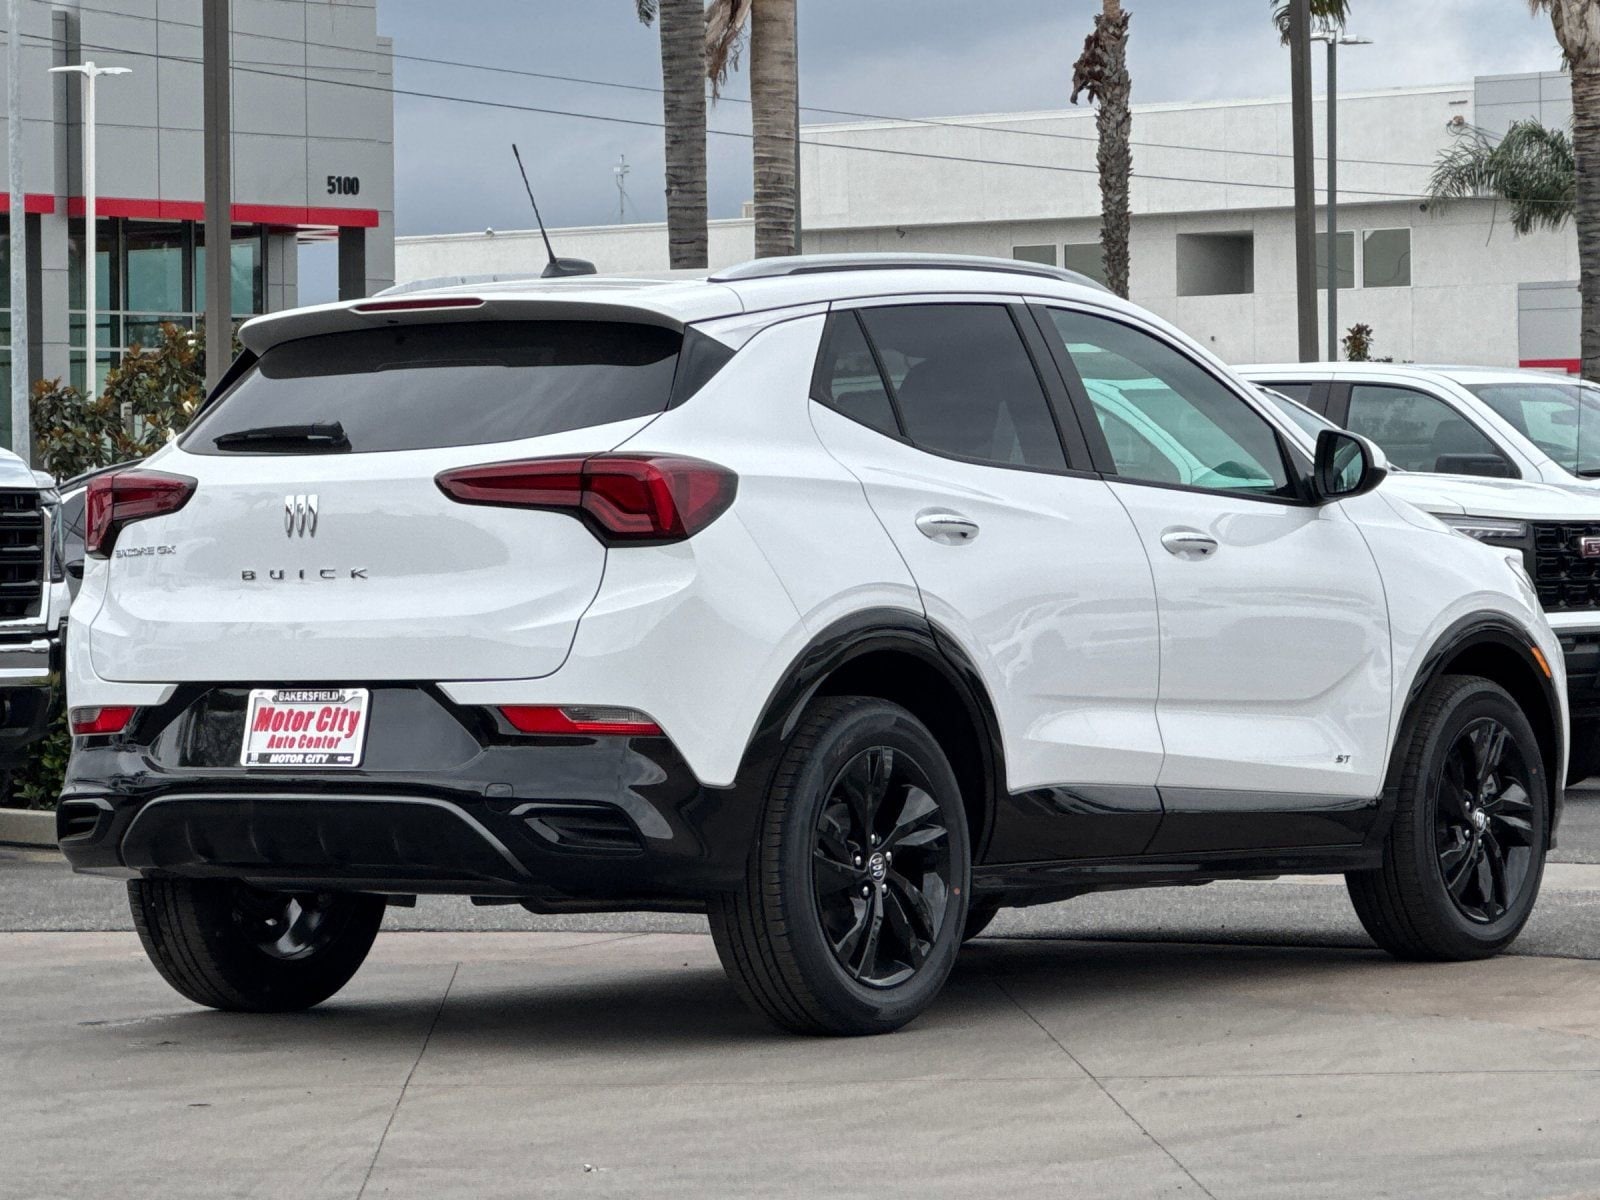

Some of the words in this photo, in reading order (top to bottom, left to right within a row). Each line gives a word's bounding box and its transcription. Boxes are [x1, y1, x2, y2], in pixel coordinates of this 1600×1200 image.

[327, 175, 360, 195] 5100
[157, 545, 176, 555] GX
[241, 568, 368, 581] BUICK
[278, 691, 339, 701] BAKERSFIELD
[253, 706, 315, 732] Motor
[315, 706, 361, 739] City
[266, 734, 297, 749] Auto
[297, 734, 341, 749] Center
[269, 754, 305, 764] MOTOR
[304, 753, 329, 763] CITY
[1335, 754, 1351, 764] ST
